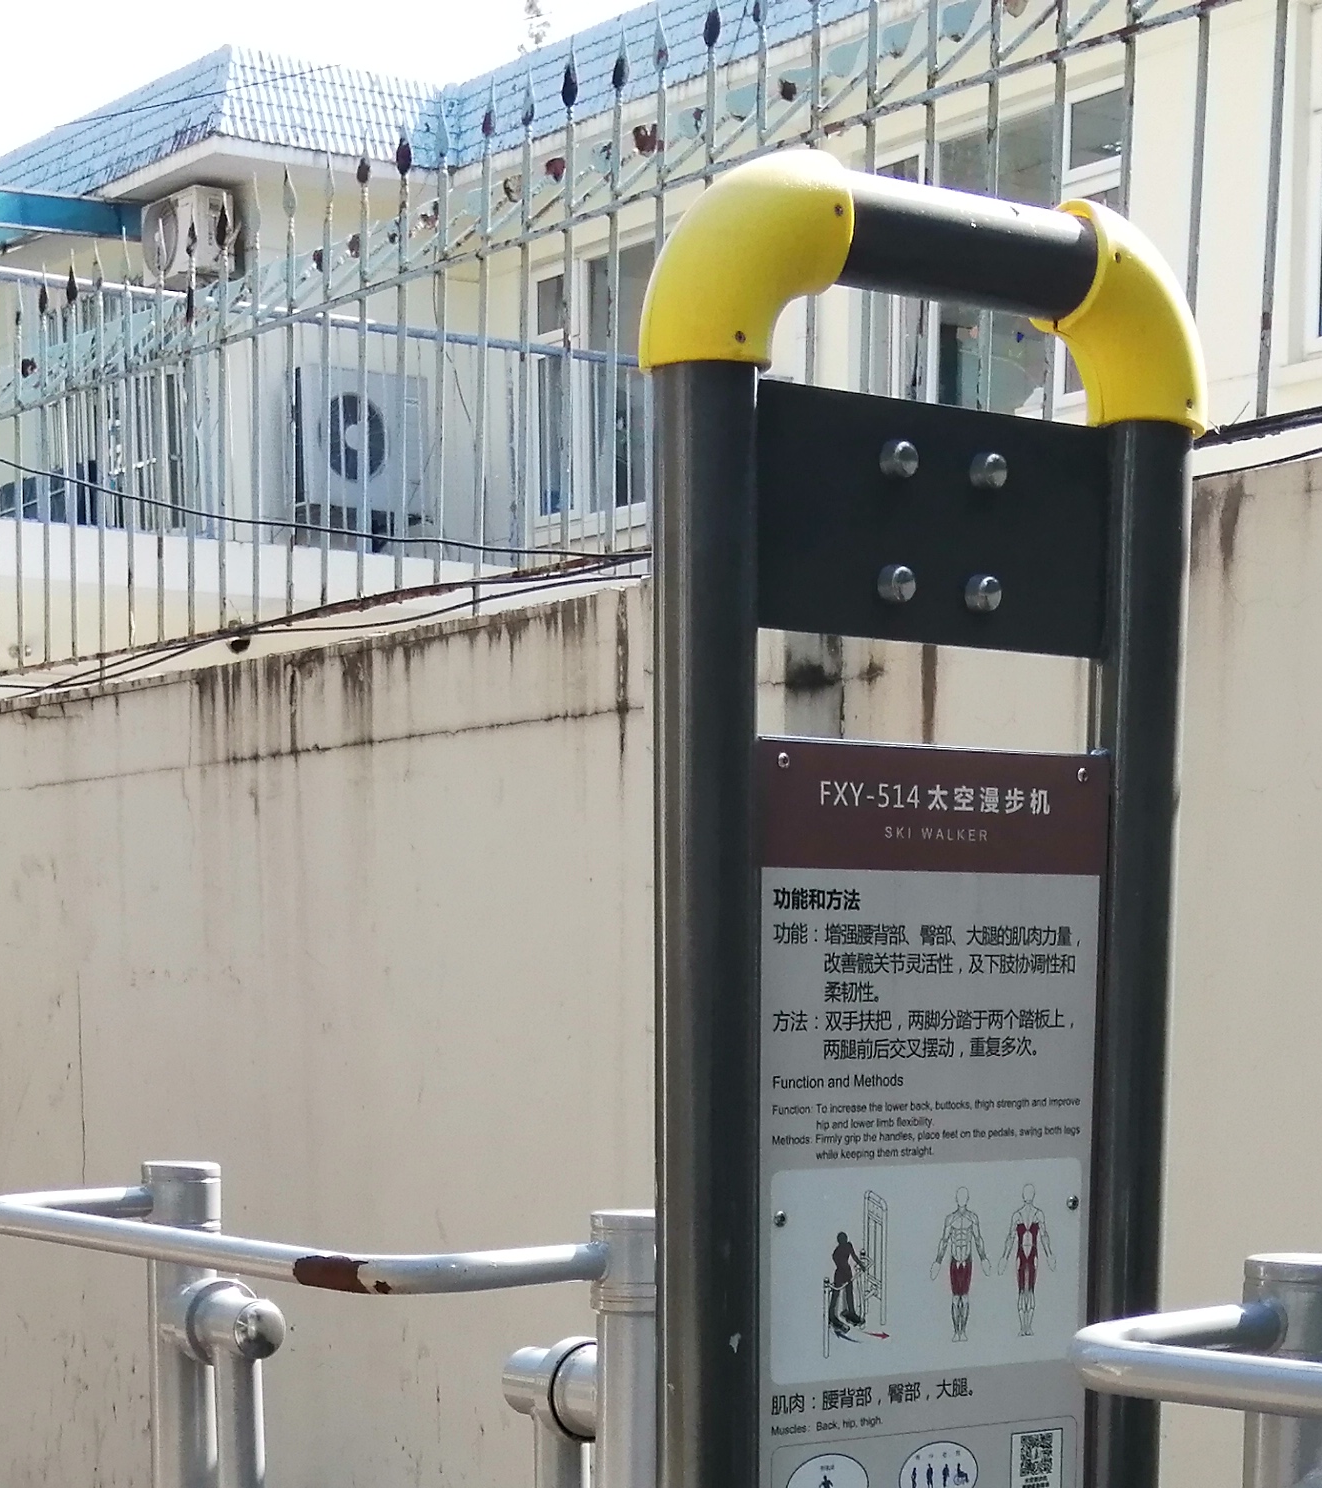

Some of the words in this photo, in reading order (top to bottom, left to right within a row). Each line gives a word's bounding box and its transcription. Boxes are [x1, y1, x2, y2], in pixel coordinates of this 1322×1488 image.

[820, 780, 920, 809] FXY-514
[927, 784, 1051, 815] 太空漫步机
[884, 826, 911, 839] SKI
[921, 827, 988, 842] WALKER
[772, 886, 861, 911] 功能和方法
[823, 979, 879, 1004] 柔韧性。
[822, 1035, 1037, 1061] 两腿前后交叉摆动，重复多次。
[771, 1074, 825, 1090] Function
[827, 1073, 850, 1089] and
[853, 1072, 904, 1088] Methods
[815, 1102, 828, 1114] To
[829, 1103, 867, 1114] increase
[868, 1101, 883, 1113] the
[884, 1101, 908, 1112] lower
[909, 1100, 933, 1112] back,
[934, 1099, 972, 1110] buttocks,
[974, 1098, 995, 1111] thigh
[996, 1098, 1030, 1110] strength
[1031, 1097, 1047, 1107] and
[815, 1119, 830, 1132] hip
[831, 1118, 849, 1130] and
[850, 1118, 875, 1129] lower
[875, 1117, 895, 1128] limb
[815, 1132, 843, 1146] Firmly
[843, 1132, 862, 1146] grip
[862, 1131, 877, 1142] the
[878, 1131, 915, 1142] handles,
[916, 1130, 941, 1142] place
[941, 1129, 958, 1139] feet
[959, 1130, 971, 1139] on
[972, 1128, 986, 1138] the
[987, 1127, 1017, 1140] pedals,
[1019, 1126, 1043, 1138] swing
[1044, 1125, 1062, 1135] both
[1063, 1125, 1081, 1137] legs
[815, 1148, 839, 1160] while
[840, 1148, 875, 1161] keeping
[876, 1147, 899, 1158] them
